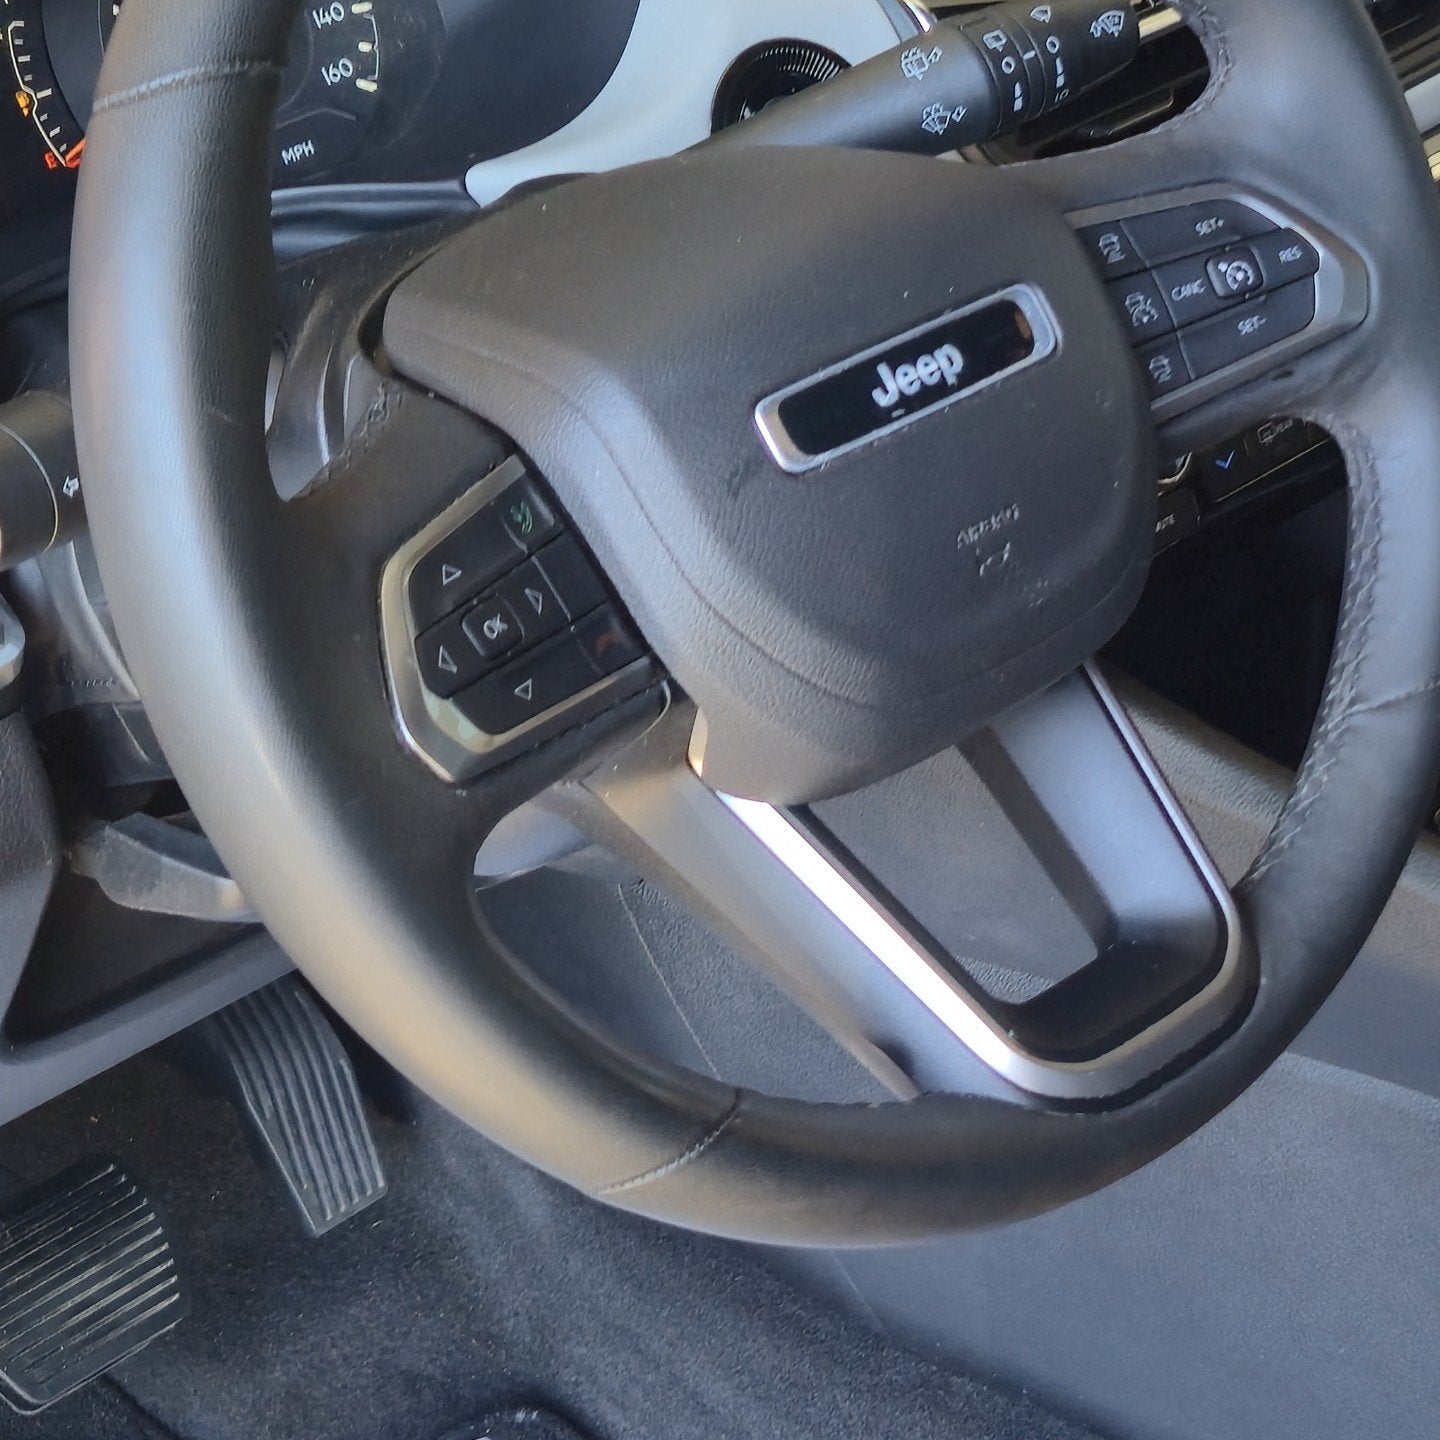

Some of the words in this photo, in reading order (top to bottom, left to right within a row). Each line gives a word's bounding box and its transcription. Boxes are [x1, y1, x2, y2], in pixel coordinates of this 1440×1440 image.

[312, 0, 345, 30] 140
[321, 57, 354, 86] 160
[281, 139, 316, 166] MPH
[1170, 278, 1208, 302] CANC
[871, 343, 964, 408] Jeep
[483, 613, 509, 640] OK
